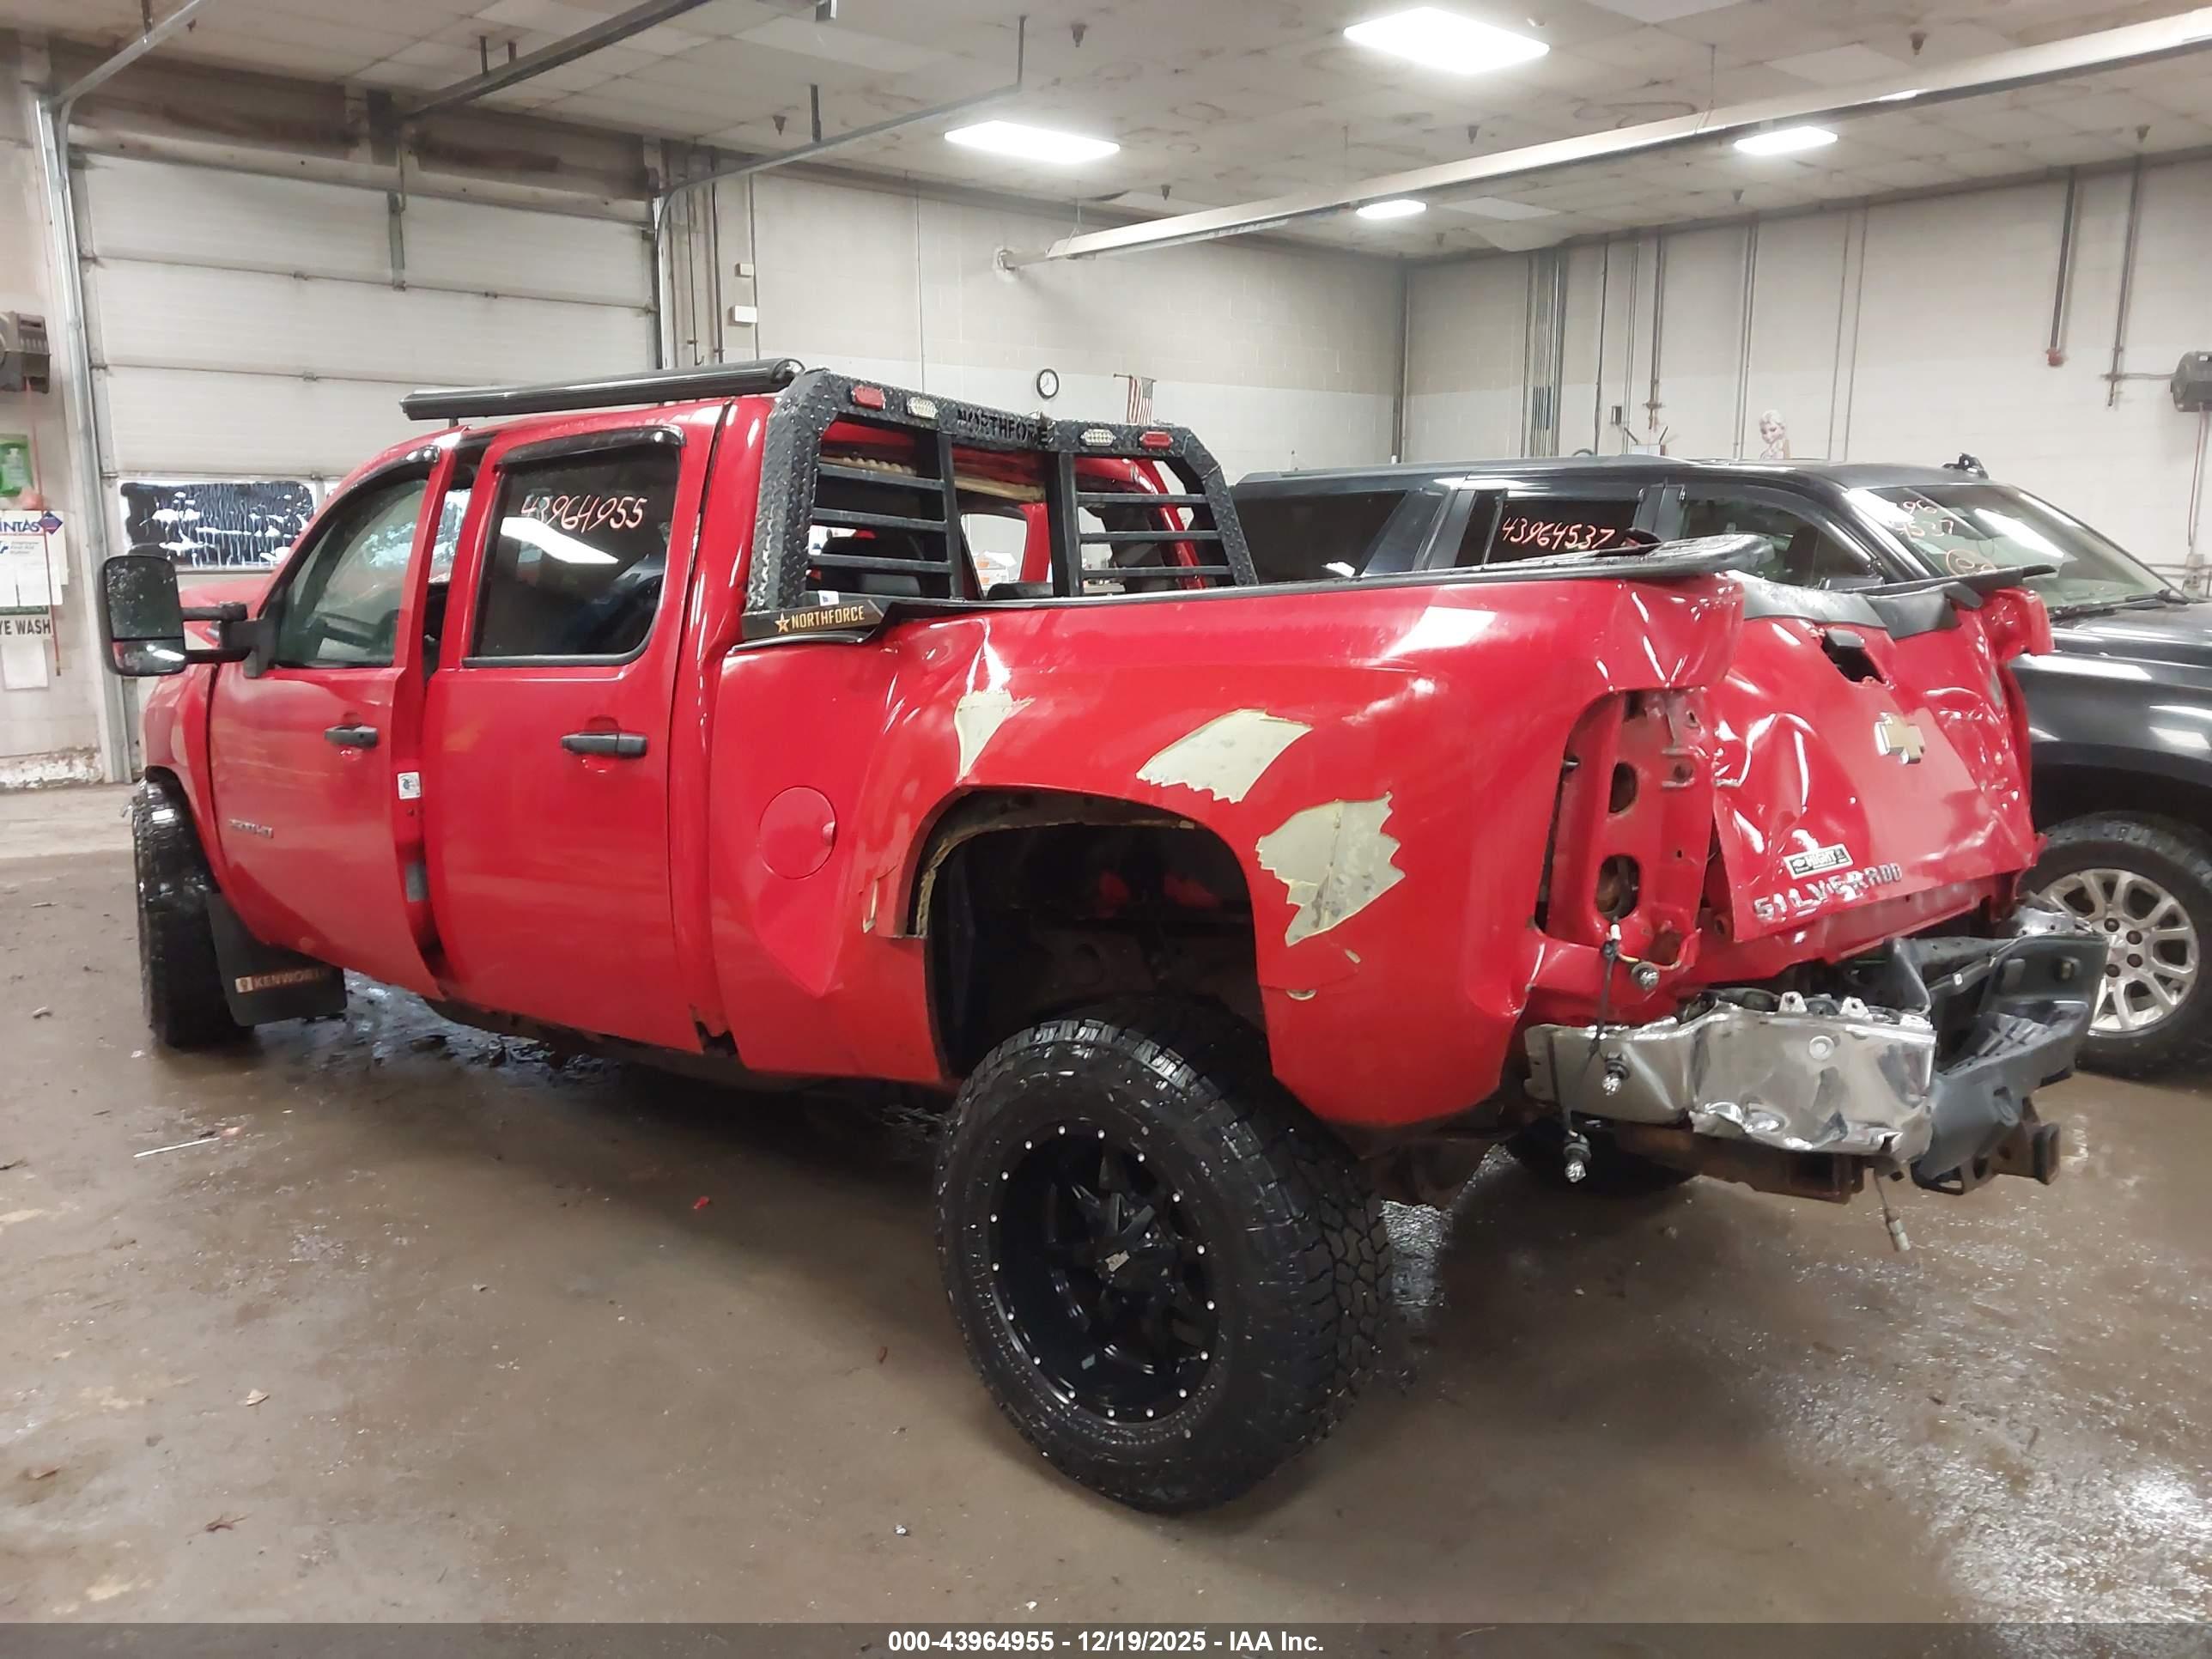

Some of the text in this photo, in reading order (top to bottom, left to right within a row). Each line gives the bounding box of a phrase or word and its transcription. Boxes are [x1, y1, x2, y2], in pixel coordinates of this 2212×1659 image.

[520, 494, 647, 533] 43964955
[1503, 516, 1616, 550] 43964537
[15, 618, 51, 635] WASH
[791, 605, 866, 629] NORTHFORCE
[1754, 863, 1903, 921] SILVERADO
